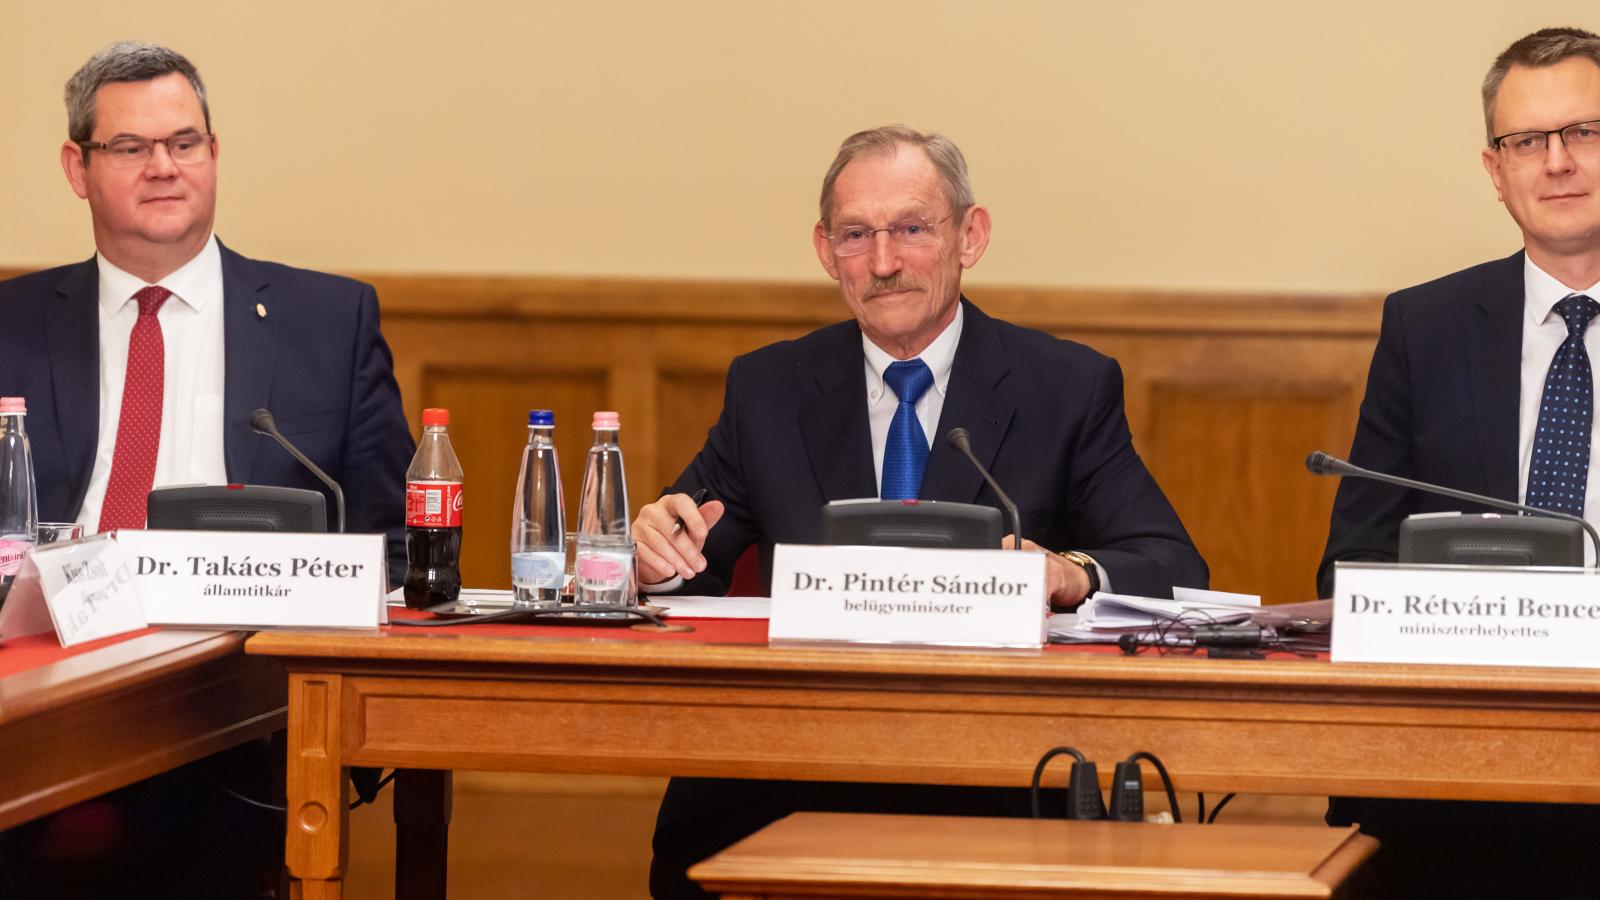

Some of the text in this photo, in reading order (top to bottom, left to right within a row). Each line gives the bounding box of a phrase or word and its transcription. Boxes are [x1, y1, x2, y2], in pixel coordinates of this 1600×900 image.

[137, 555, 364, 579] Dr. Takács Péter
[203, 584, 291, 598] államtitkár
[793, 572, 1028, 596] Dr. Pintér Sándor
[844, 599, 973, 615] belügyminiszter
[1350, 594, 1600, 619] Dr. Rétvári Bence
[1400, 623, 1550, 639] miniszterhelyettes
